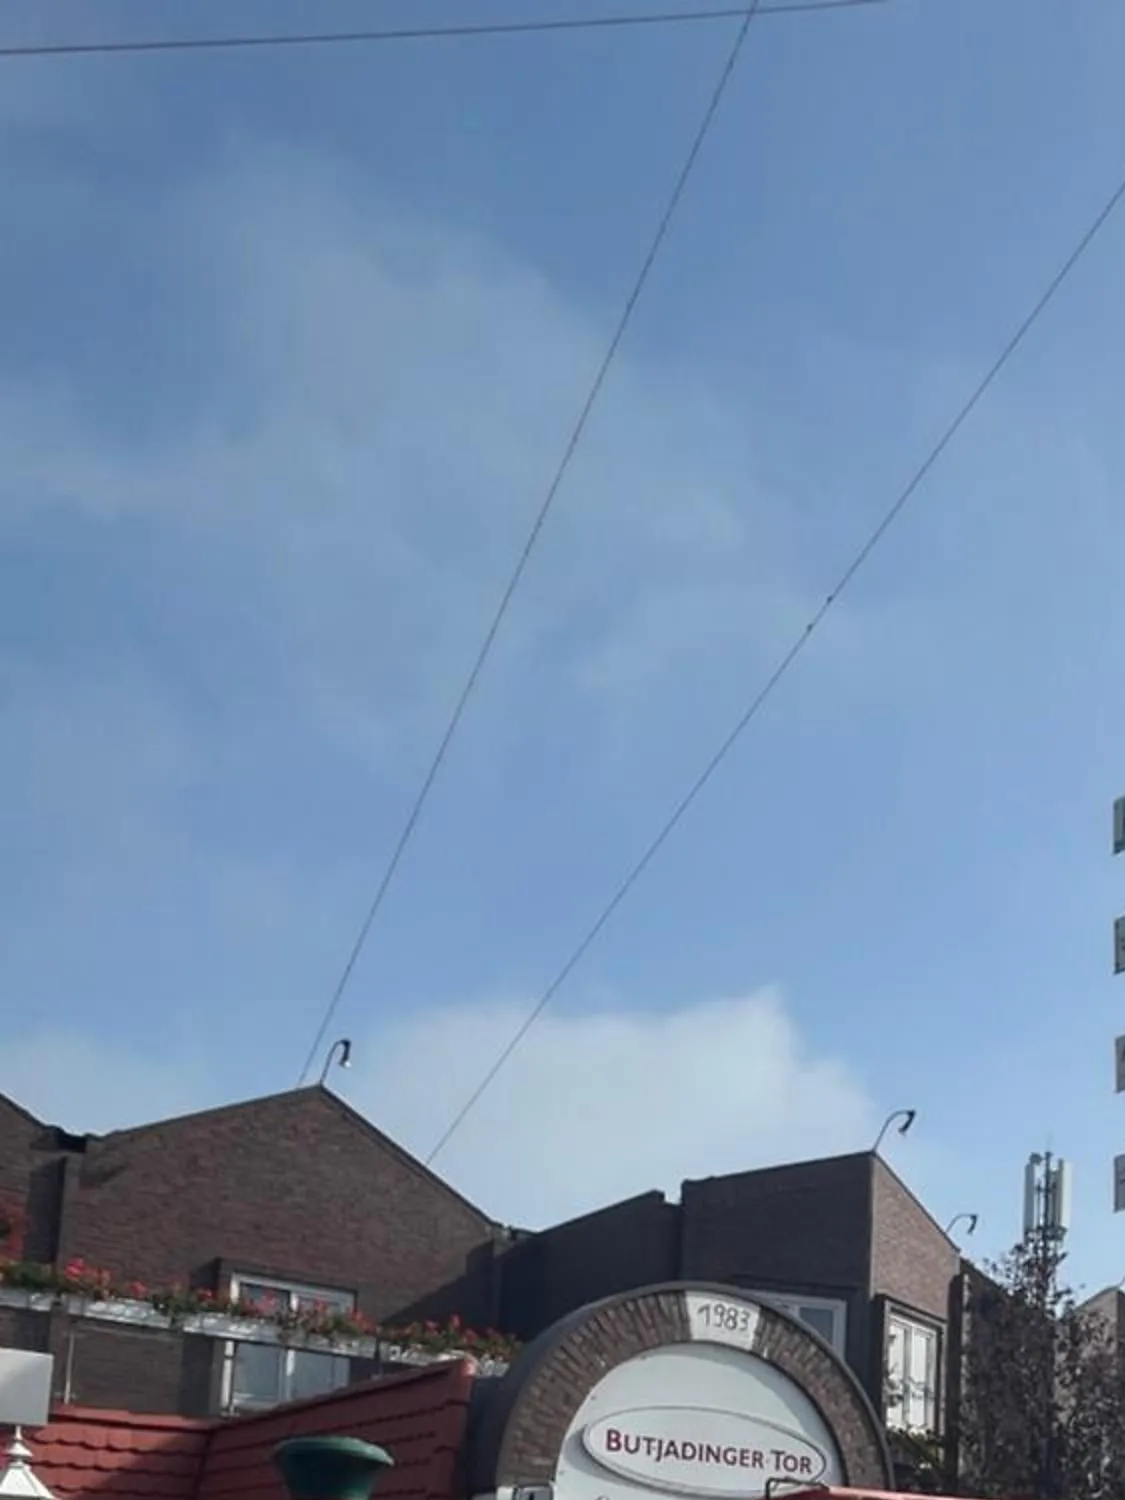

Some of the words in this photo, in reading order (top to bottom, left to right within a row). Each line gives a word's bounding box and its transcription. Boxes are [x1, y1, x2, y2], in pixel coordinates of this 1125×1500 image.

[697, 1302, 751, 1332] 1983
[605, 1429, 764, 1469] BUTJADINGER
[769, 1449, 812, 1474] TOR
